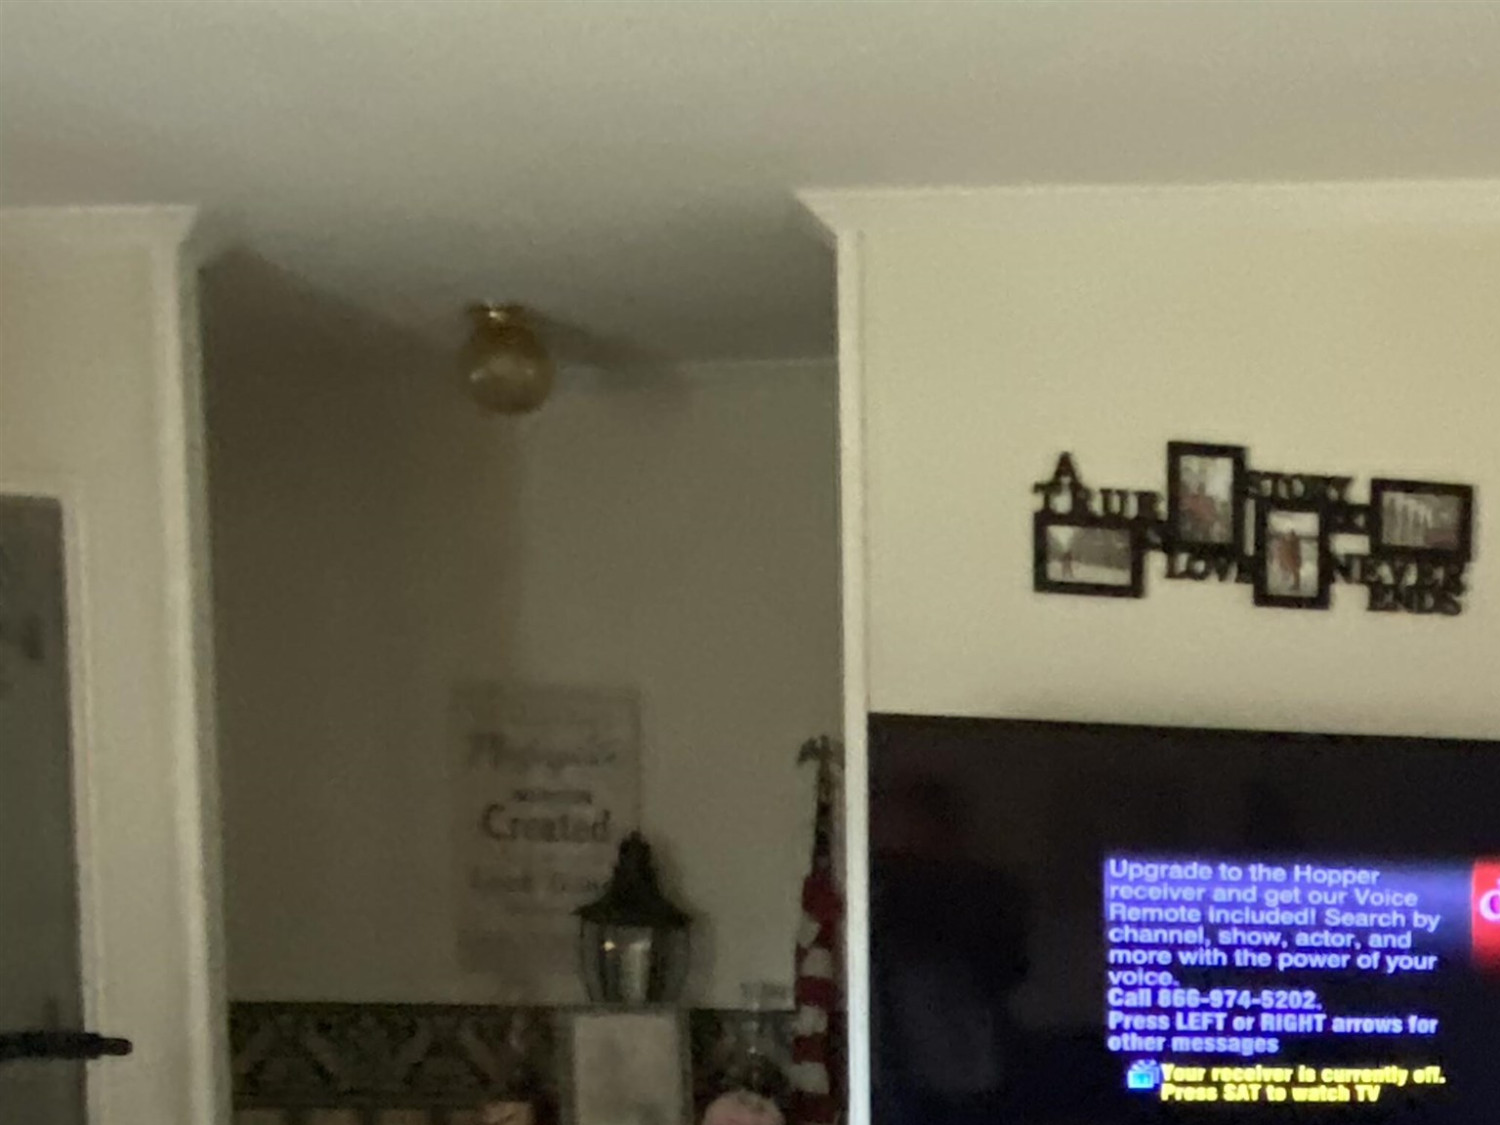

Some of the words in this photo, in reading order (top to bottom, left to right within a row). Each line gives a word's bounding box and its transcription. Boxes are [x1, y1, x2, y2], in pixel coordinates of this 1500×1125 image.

[1109, 859, 1213, 882] Upgrade
[1219, 863, 1243, 881] to
[1248, 863, 1287, 882] the
[1293, 864, 1380, 887] Hopper
[1109, 882, 1206, 901] receiver
[1212, 885, 1257, 903] and
[1264, 887, 1301, 907] get
[1308, 889, 1348, 905] our
[1354, 888, 1418, 907] Voice
[1108, 902, 1201, 923] Remote
[1324, 907, 1406, 928] Search
[1412, 909, 1441, 933] by
[1108, 924, 1212, 948] channel,
[1218, 926, 1289, 949] show,
[1295, 930, 1362, 950] actor,
[1368, 931, 1413, 949] and
[1108, 948, 1173, 965] more
[1178, 947, 1228, 966] with
[1234, 949, 1272, 967] the
[1278, 952, 1351, 972] power
[1356, 951, 1381, 970] of
[1386, 955, 1438, 974] your
[1107, 967, 1181, 987] voice.
[1107, 986, 1152, 1008] Call
[1108, 1010, 1171, 1031] Press
[1175, 1011, 1228, 1032] LEFT
[1232, 1015, 1256, 1032] or
[1260, 1012, 1327, 1033] RIGHT
[1332, 1016, 1404, 1034] arrows
[1408, 1014, 1439, 1034] for
[1107, 1032, 1167, 1052] other
[1171, 1035, 1280, 1057] messages
[1160, 1063, 1207, 1082] Your
[1211, 1064, 1294, 1083] receiver
[1298, 1064, 1317, 1083] is
[1321, 1065, 1409, 1087] currently
[1160, 1083, 1218, 1102] Press
[1223, 1083, 1262, 1102] SAT
[1266, 1084, 1288, 1102] to
[1292, 1084, 1351, 1103] watch
[1355, 1084, 1381, 1103] TV
